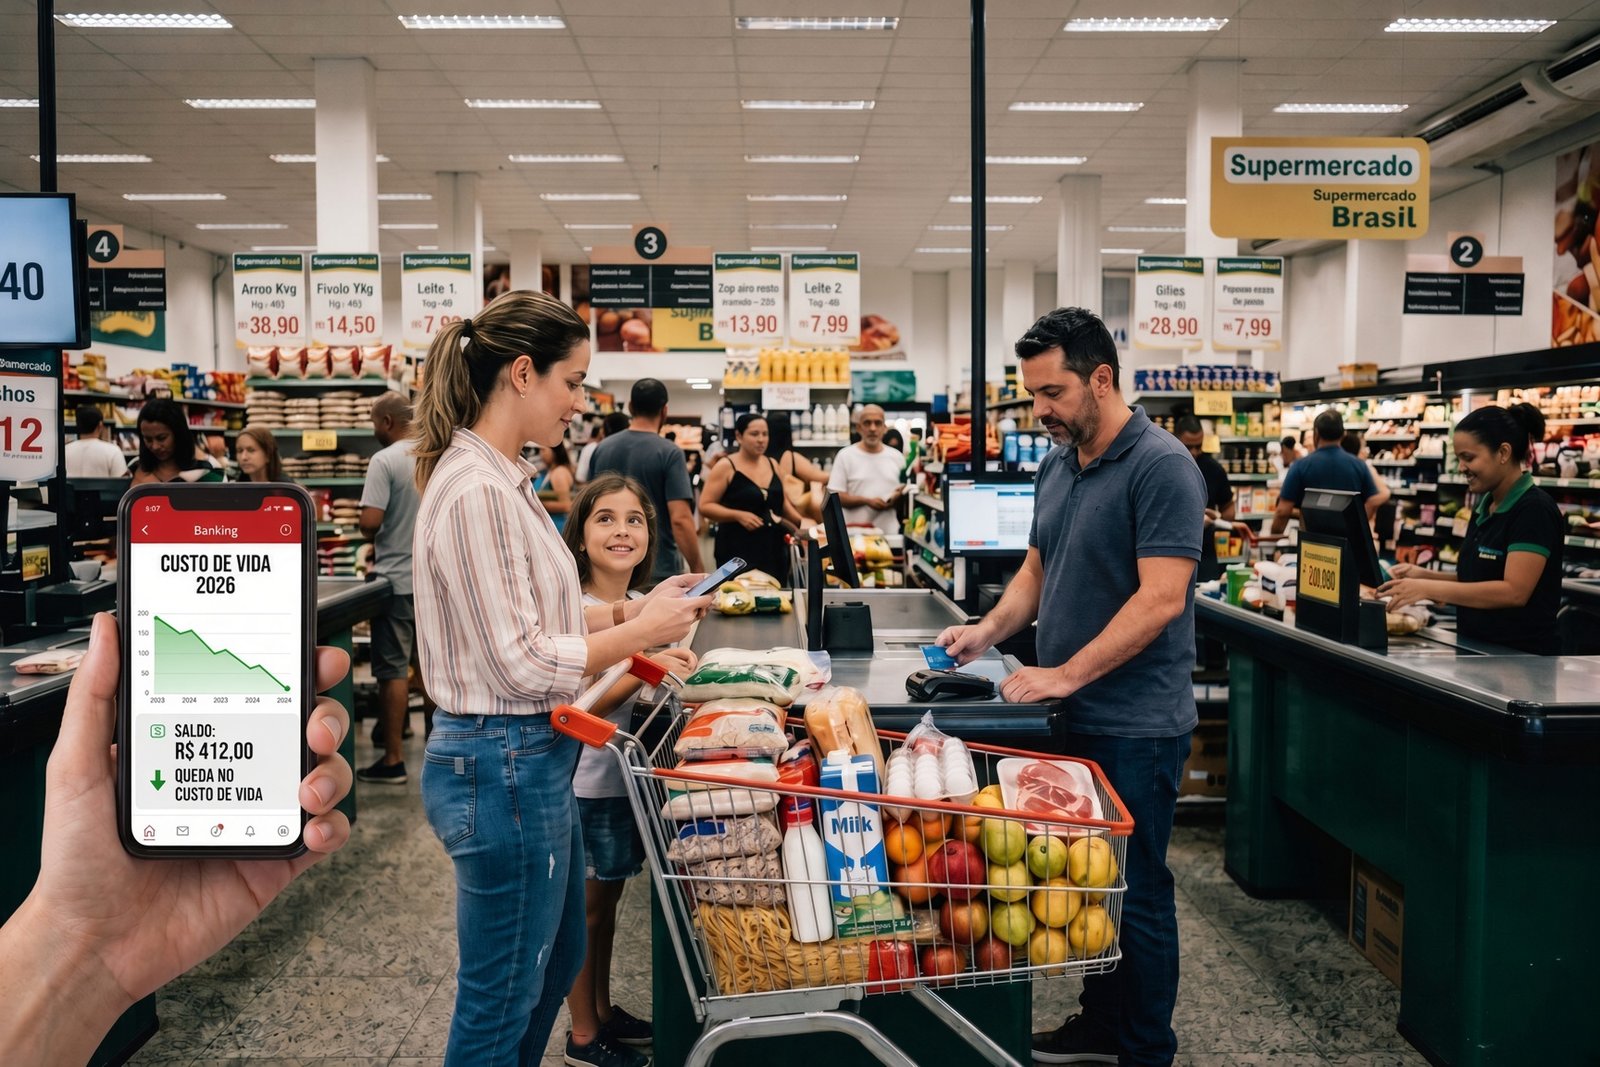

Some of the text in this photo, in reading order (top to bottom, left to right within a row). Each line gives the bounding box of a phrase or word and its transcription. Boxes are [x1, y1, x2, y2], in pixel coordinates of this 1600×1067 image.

[1231, 154, 1413, 181] Supermercado
[1313, 189, 1417, 204] Supermercado
[1332, 206, 1417, 228] Brasil
[95, 236, 111, 257] 4
[643, 232, 659, 254] 3
[1459, 241, 1474, 262] 2
[0, 262, 44, 300] 40
[241, 283, 297, 297] Arroo Kvg
[317, 283, 350, 295] Fivolo
[417, 283, 445, 294] Leite
[835, 283, 842, 294] 2
[250, 316, 299, 337] 38,90
[327, 316, 375, 337] 14,50
[730, 315, 777, 335] 13,90
[811, 315, 848, 335] 7,99
[1150, 317, 1198, 338] 28,90
[1234, 318, 1271, 339] 7,99
[0, 385, 35, 402] hos
[194, 525, 238, 538] Banking
[161, 555, 271, 572] CUSTO DE VIDA
[196, 576, 235, 594] 2026
[174, 724, 215, 738] SALDO:
[175, 741, 253, 762] R$ 412,00
[175, 768, 234, 784] QUEDA NO
[175, 787, 263, 801] CUSTO DE VIDA
